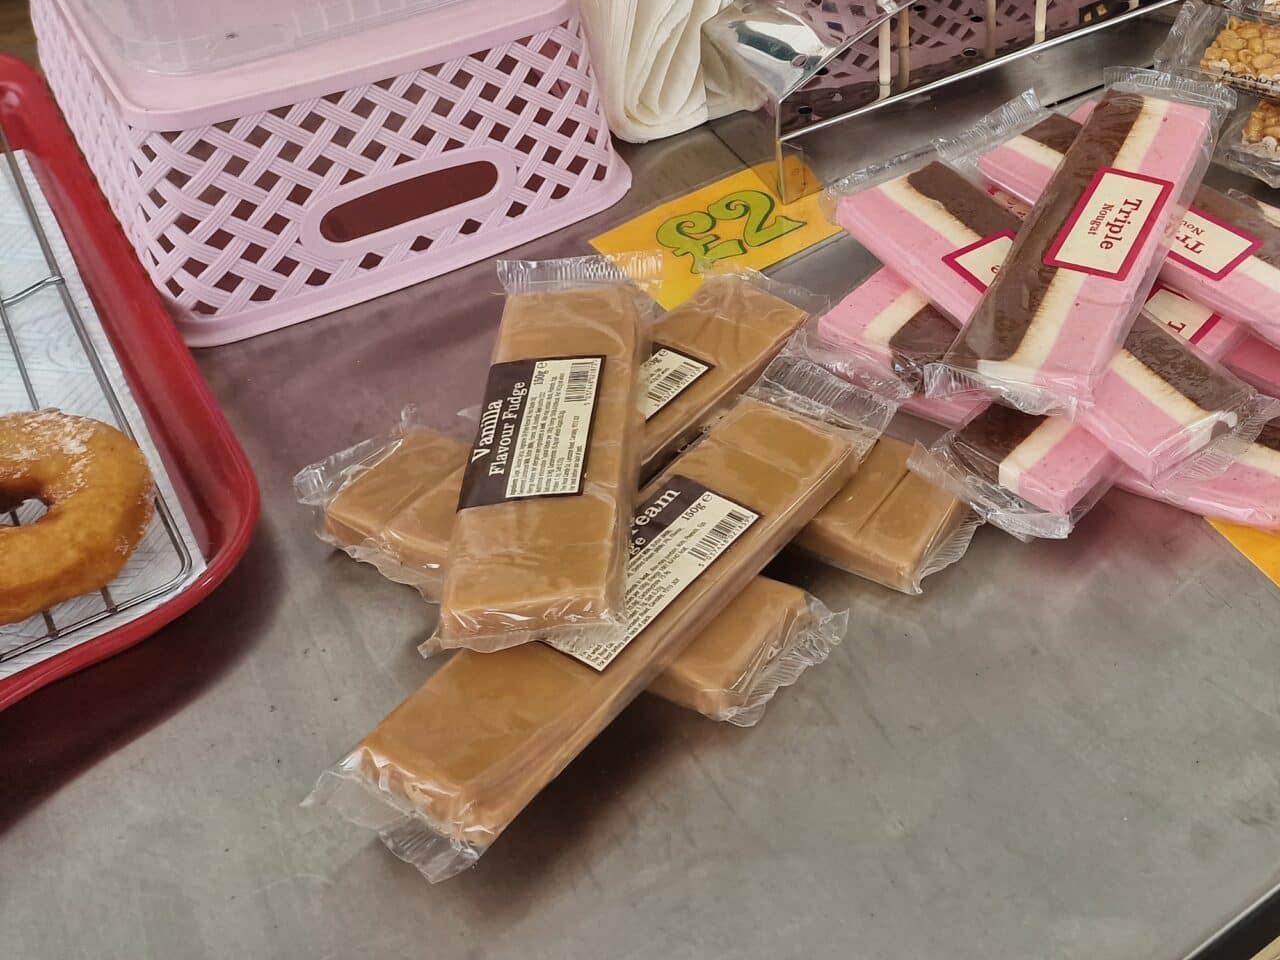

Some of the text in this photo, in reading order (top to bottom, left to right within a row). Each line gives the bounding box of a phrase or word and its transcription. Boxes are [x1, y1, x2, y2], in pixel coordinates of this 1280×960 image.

[1223, 70, 1276, 87] PEANUT
[655, 189, 808, 275] £2
[1087, 203, 1114, 235] Nougat
[1099, 198, 1143, 251] Triple
[471, 398, 503, 464] Vanilla
[488, 380, 527, 476] Flavour Fudge
[633, 488, 682, 533] ream
[681, 501, 707, 521] 150g
